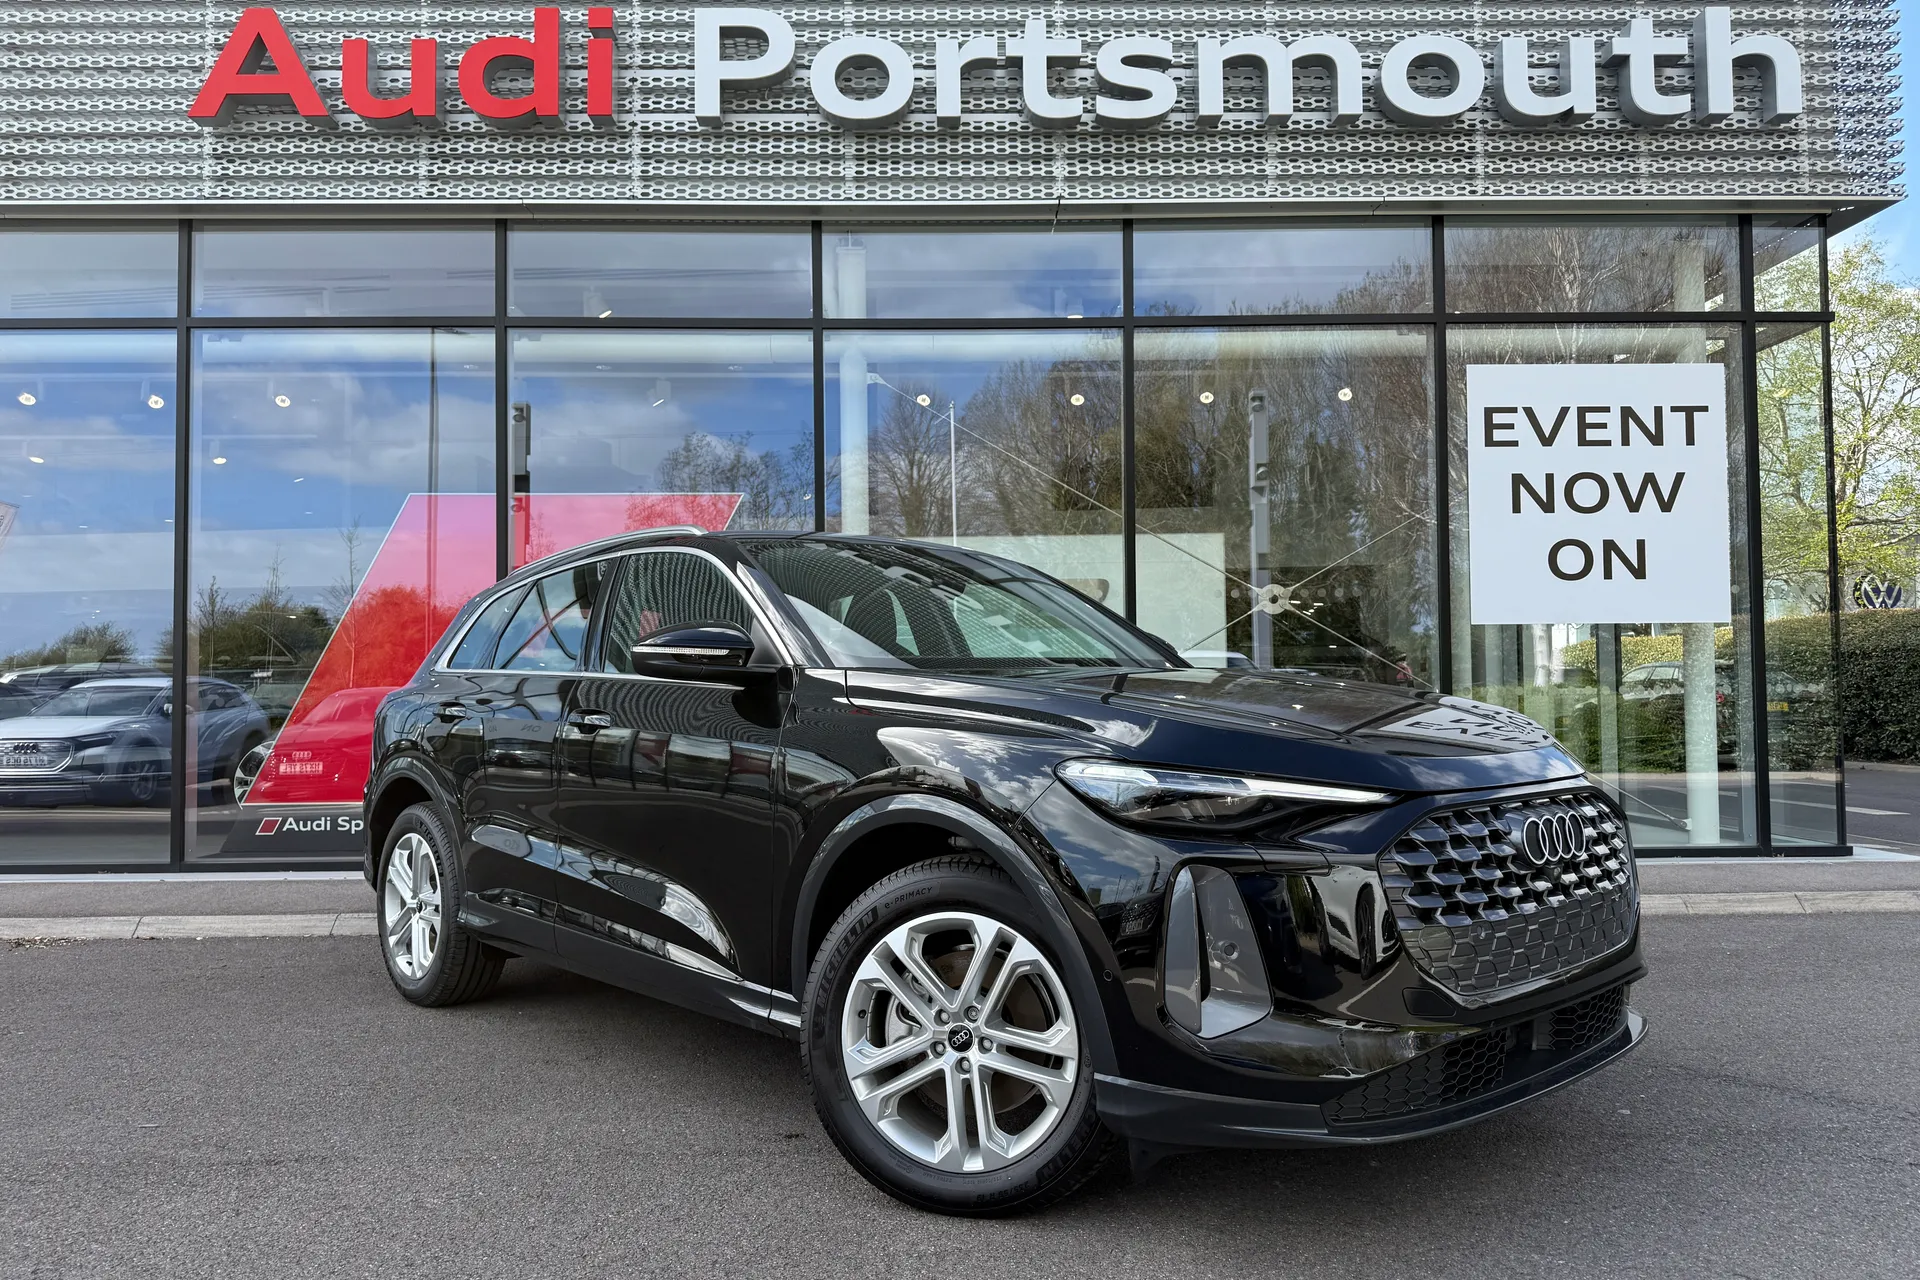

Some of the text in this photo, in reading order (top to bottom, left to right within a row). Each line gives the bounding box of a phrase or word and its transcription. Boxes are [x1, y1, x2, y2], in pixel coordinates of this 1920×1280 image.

[188, 6, 1801, 125] Audi Portsmouth
[1483, 405, 1709, 448] EVENT
[1511, 471, 1686, 515] NOW
[1547, 538, 1648, 581] ON
[282, 816, 364, 834] Audi Sp
[816, 886, 933, 1010] MICHELIN e-PRIMACY
